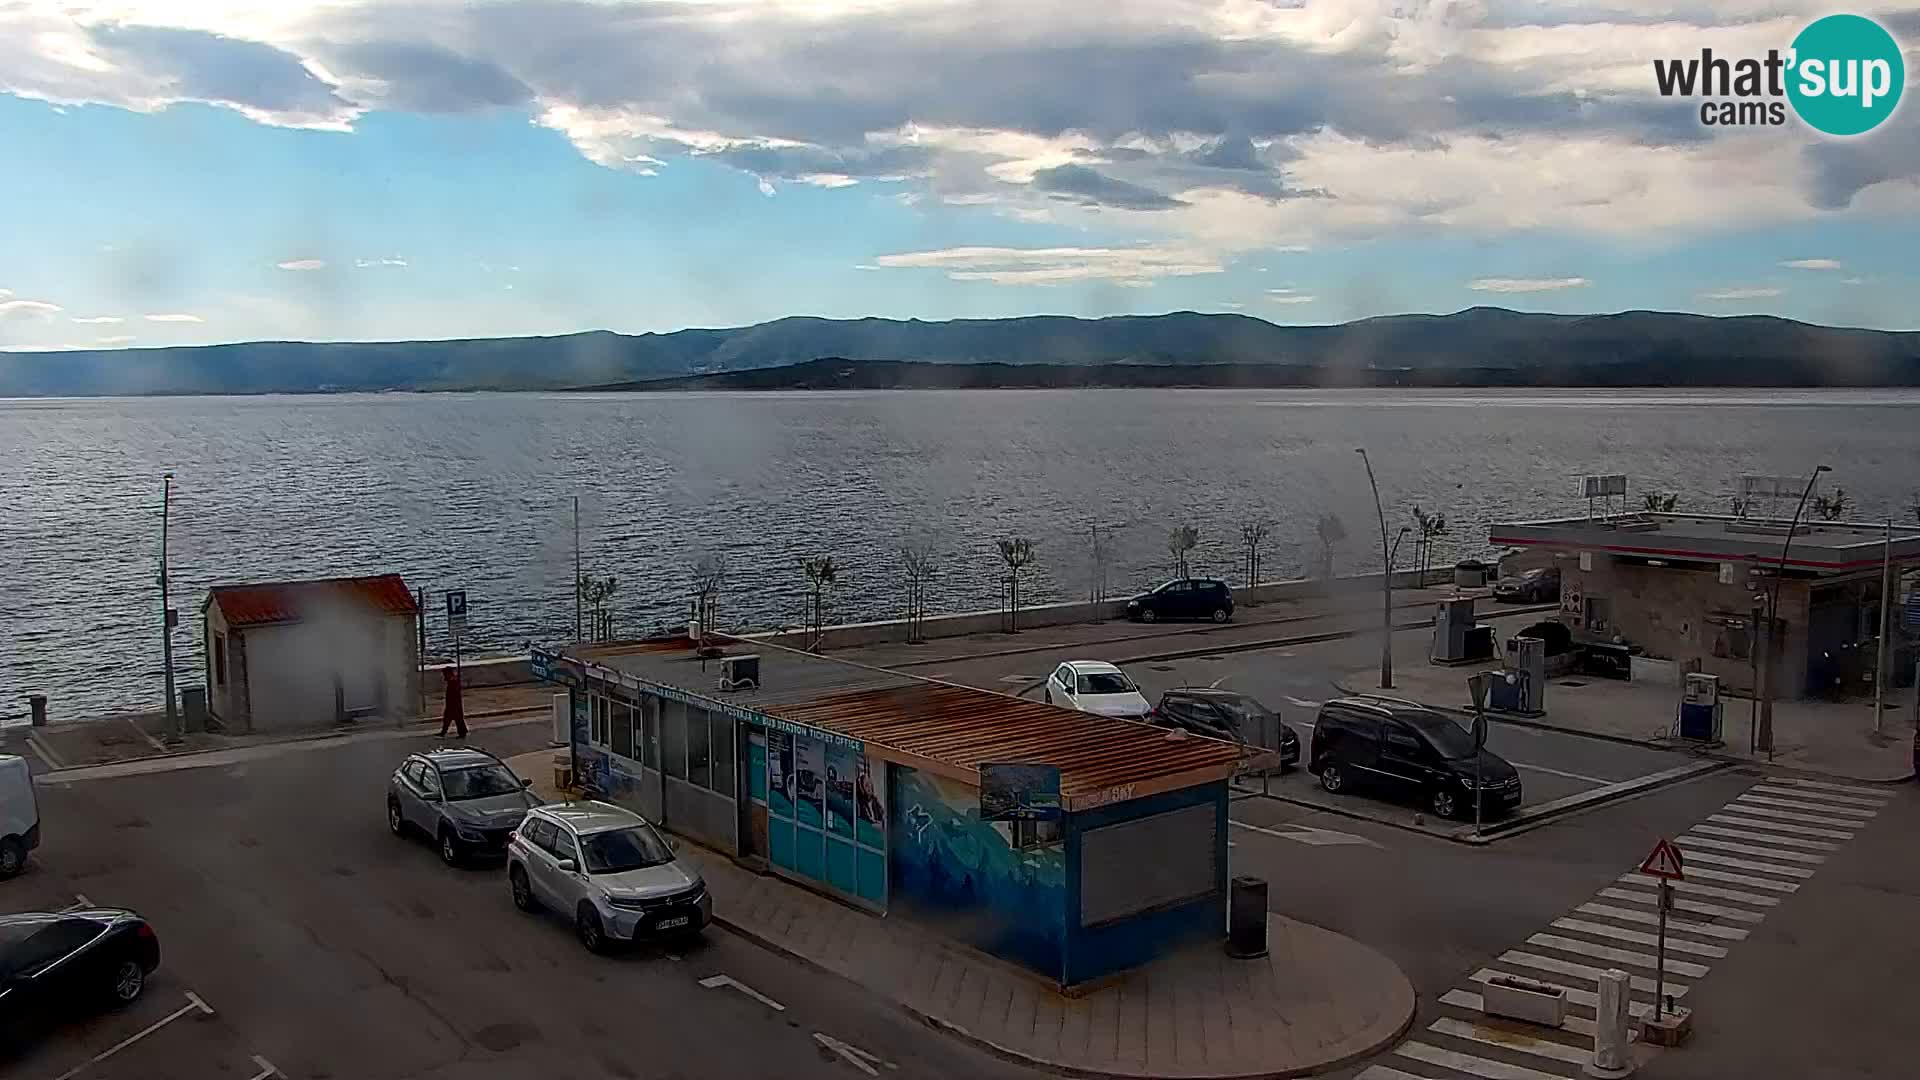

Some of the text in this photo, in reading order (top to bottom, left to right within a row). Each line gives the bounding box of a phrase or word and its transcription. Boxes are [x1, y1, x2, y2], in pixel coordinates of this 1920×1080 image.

[451, 595, 462, 612] P
[762, 718, 777, 729] BUS
[777, 721, 805, 735] STATION
[809, 729, 833, 743] TICKET
[835, 735, 860, 750] OFFICE
